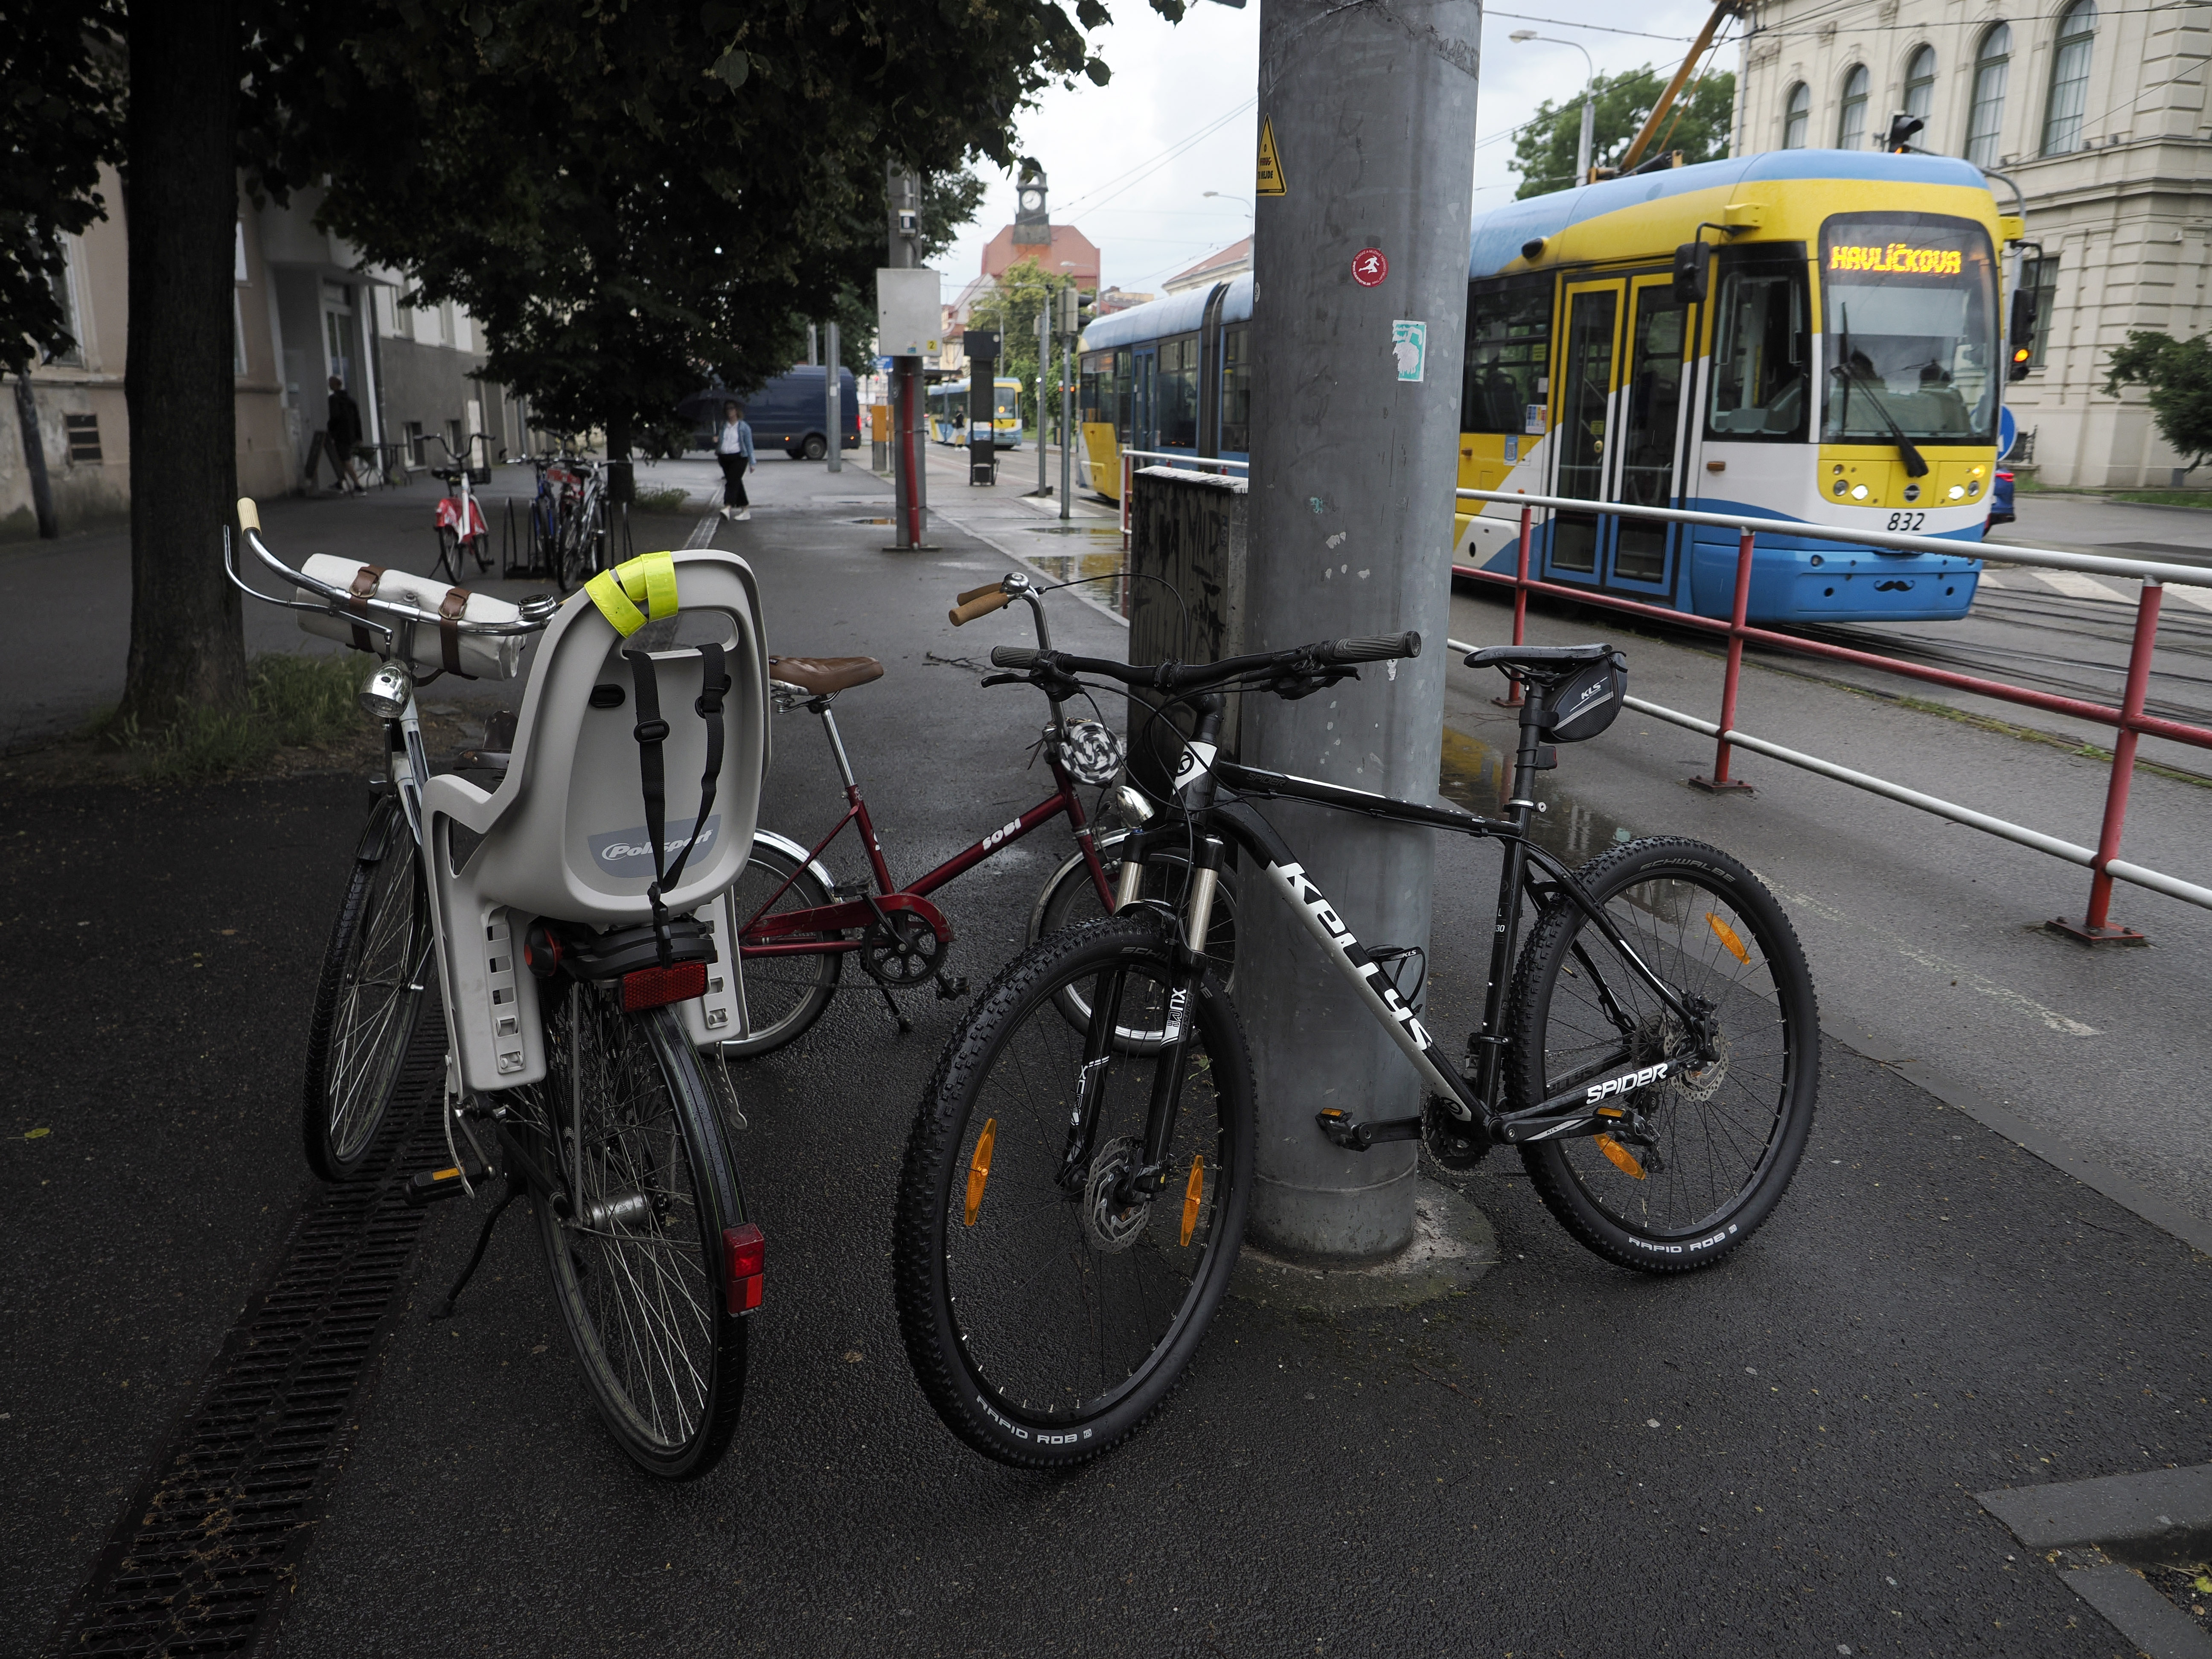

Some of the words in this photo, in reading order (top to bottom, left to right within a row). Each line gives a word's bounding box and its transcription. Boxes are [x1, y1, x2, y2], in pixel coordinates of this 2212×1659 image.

[1263, 143, 1267, 152] O
[1261, 170, 1273, 179] NEJDE
[1830, 243, 1962, 274] HAVLÍČKOVA
[1887, 512, 1925, 531] 832
[1581, 682, 1601, 700] KLS
[1246, 772, 1286, 787] SPIDER
[983, 818, 1022, 850] SOBI
[1639, 858, 1736, 882] SCHWALBE
[1498, 908, 1502, 917] L
[1402, 949, 1416, 958] KLS
[1586, 1063, 1668, 1105] SPIDER
[1629, 1237, 1682, 1253] RAPID
[1690, 1233, 1726, 1251] ROB
[976, 1394, 1028, 1439] RAPID
[1037, 1433, 1077, 1444] ROB
